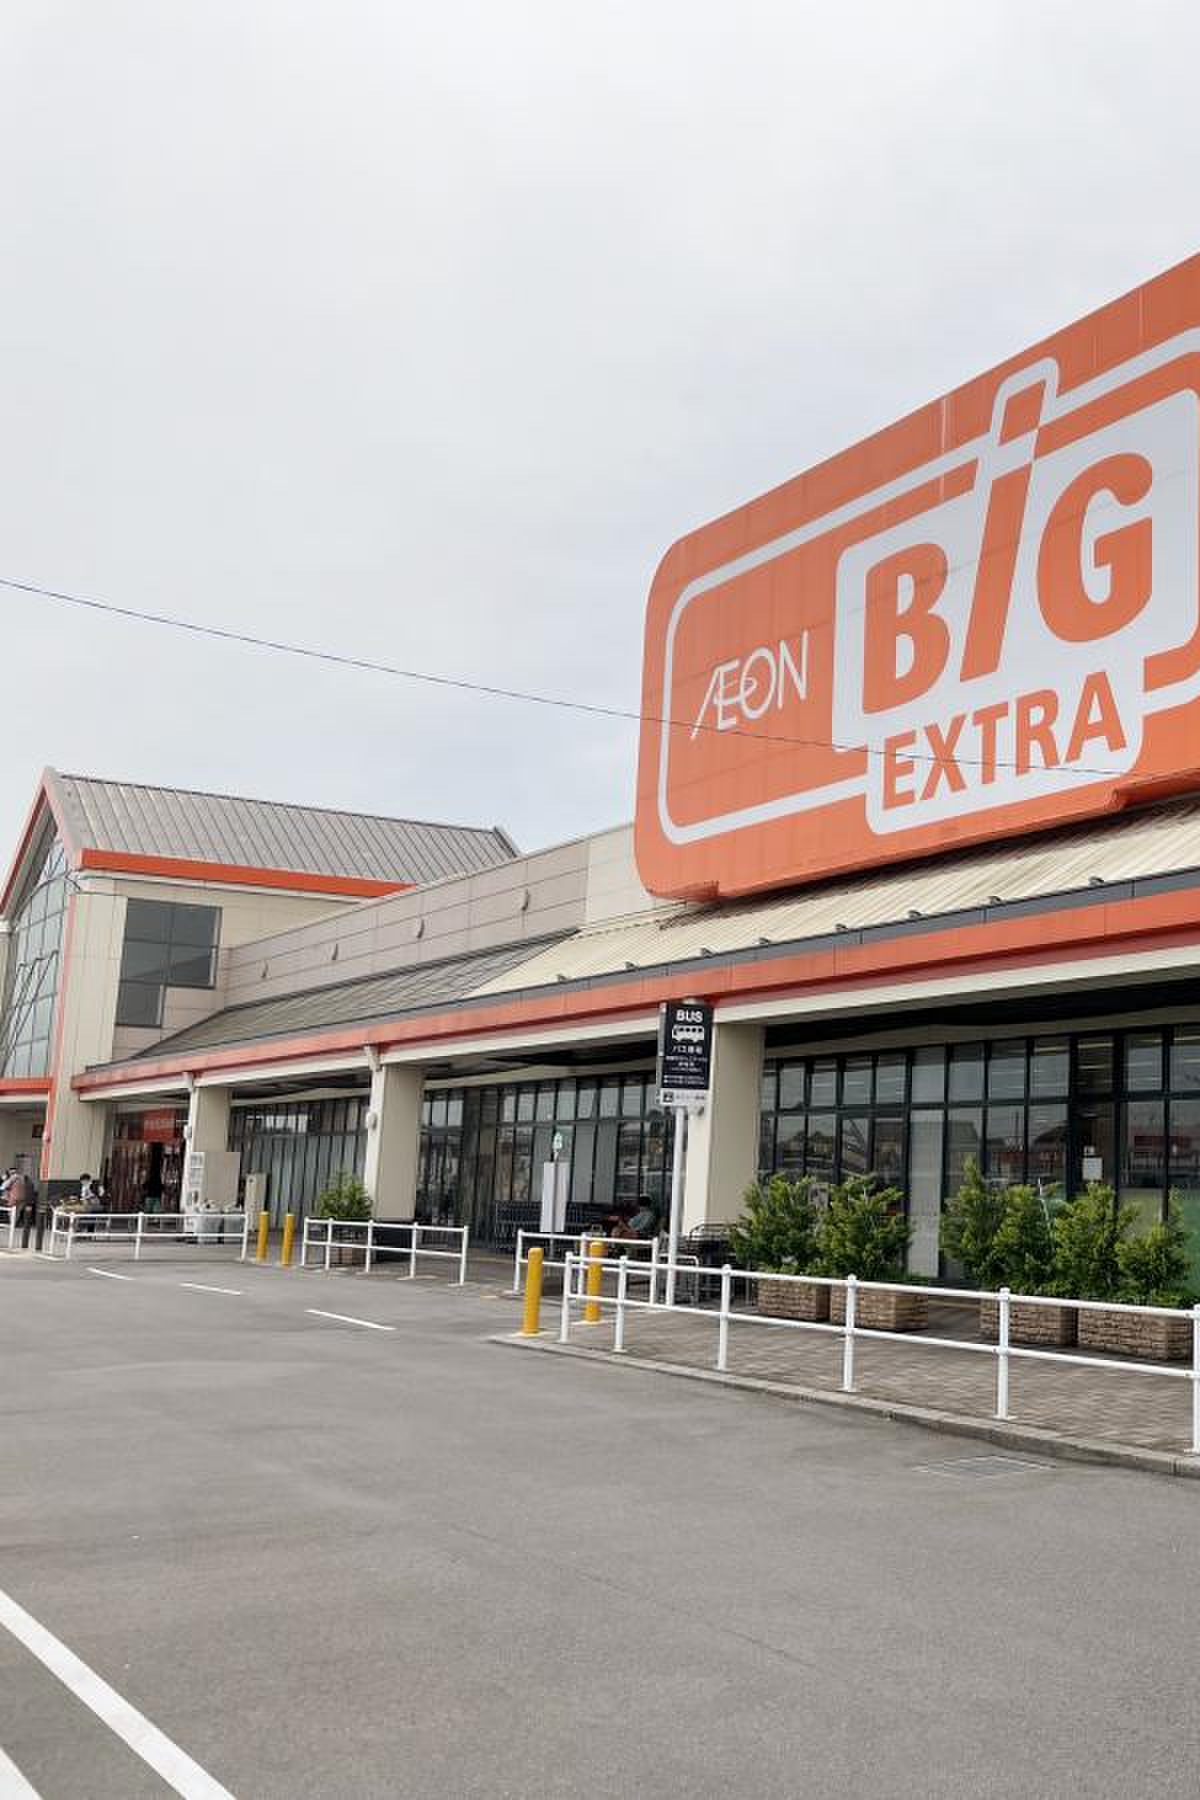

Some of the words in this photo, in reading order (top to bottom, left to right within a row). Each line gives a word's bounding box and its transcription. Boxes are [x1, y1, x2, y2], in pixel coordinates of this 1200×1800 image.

[862, 380, 1153, 715] BIG
[882, 670, 1127, 810] EXTRA
[676, 1009, 703, 1023] BUS
